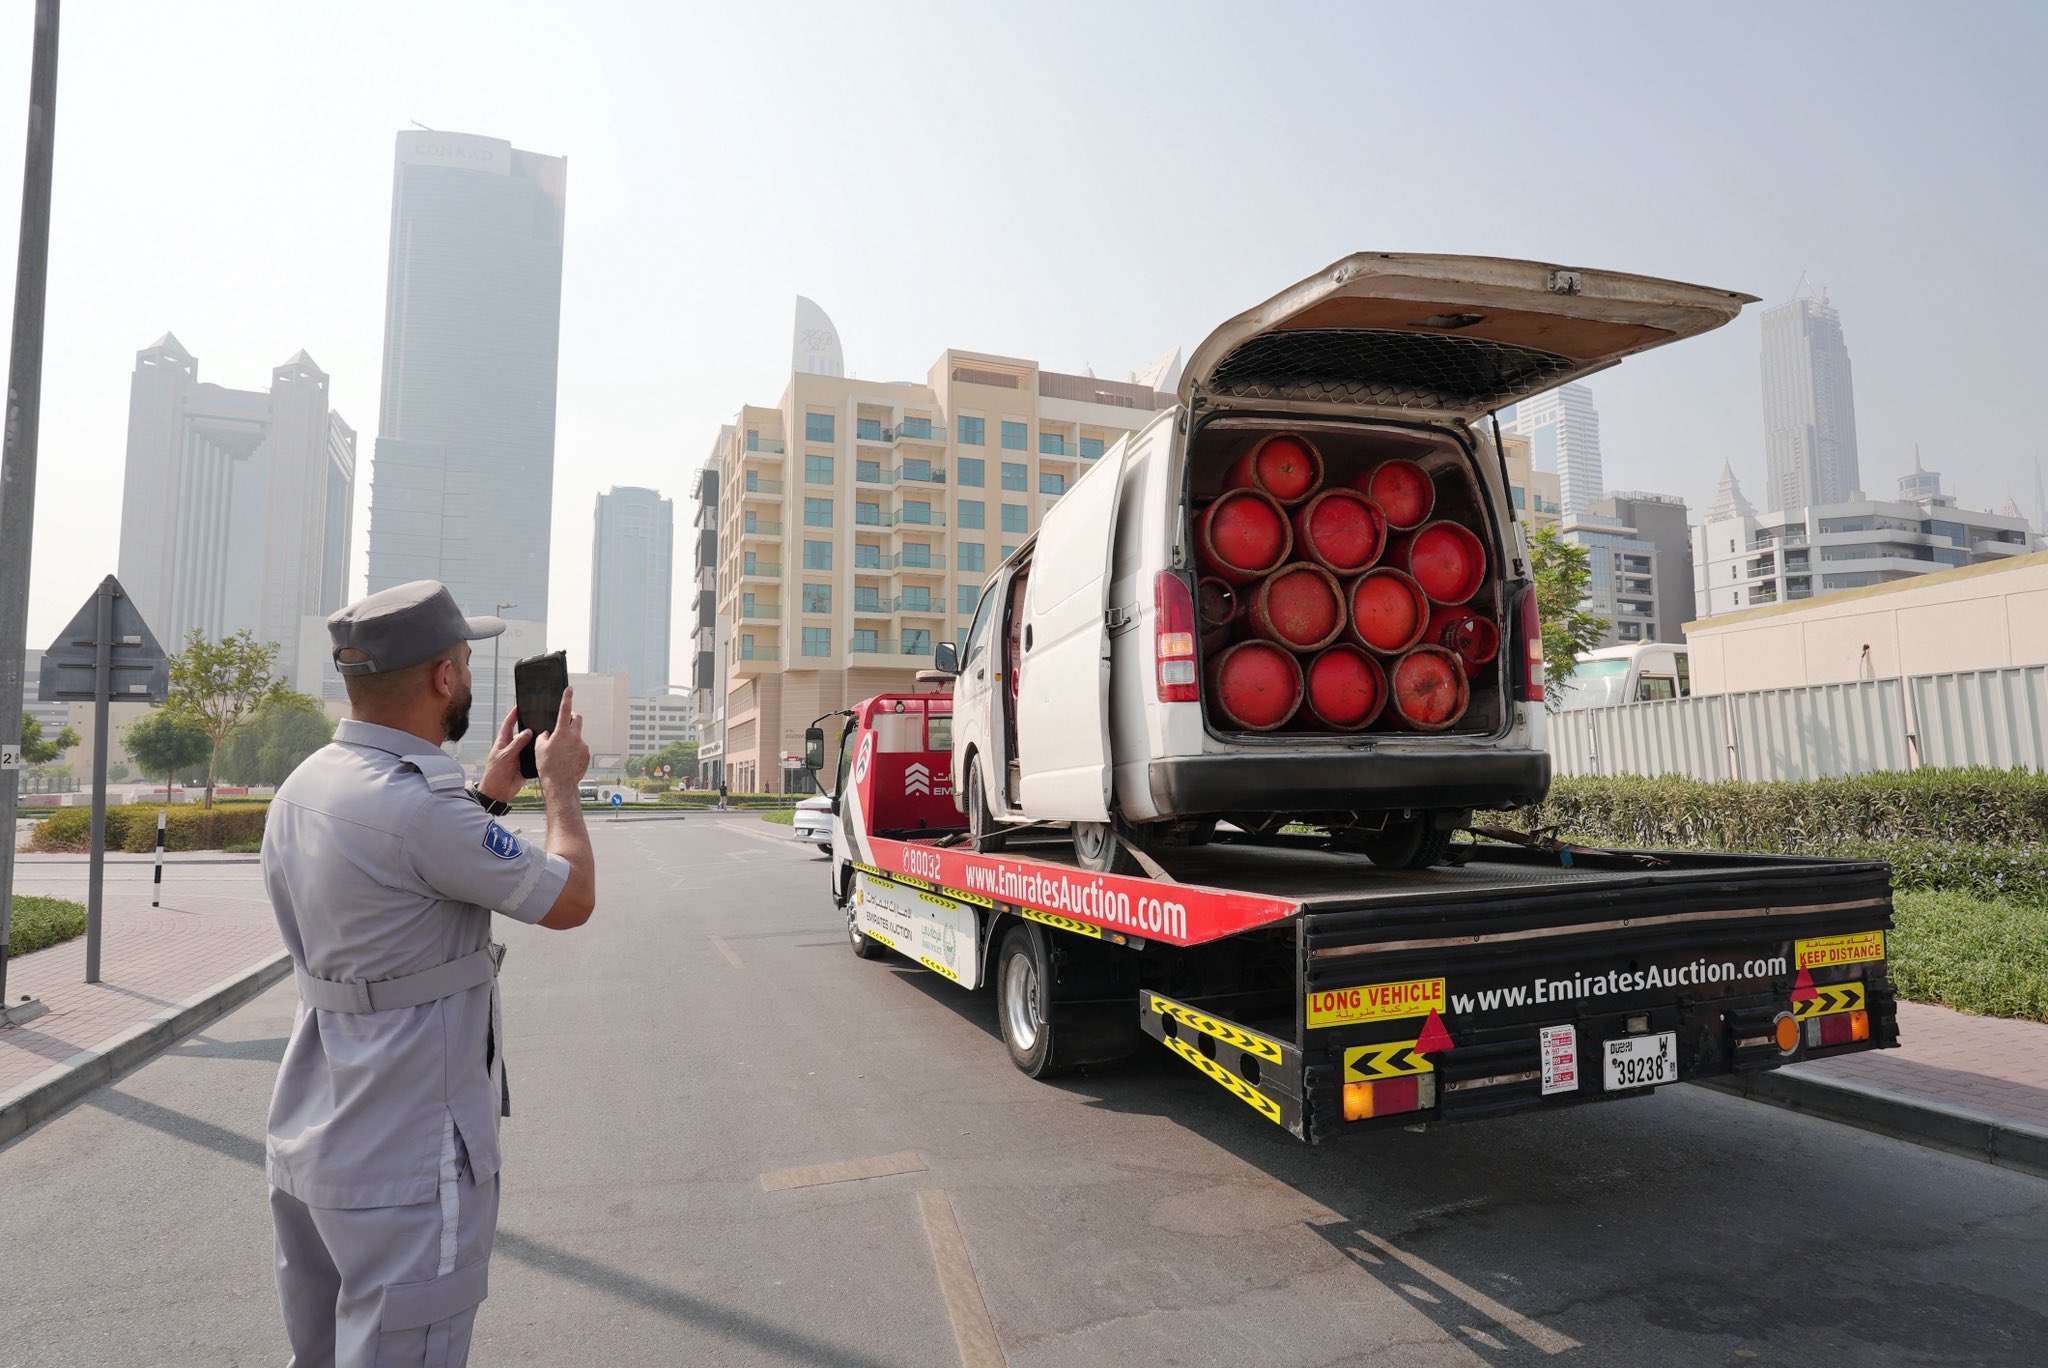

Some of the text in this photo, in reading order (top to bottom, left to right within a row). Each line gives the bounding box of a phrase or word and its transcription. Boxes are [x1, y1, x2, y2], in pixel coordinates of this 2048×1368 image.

[415, 144, 494, 161] CONRAD
[910, 849, 941, 880] 80032
[965, 864, 1187, 939] www.EmiratesAuction.com
[866, 911, 913, 941] EMIRATES AUCTION
[1799, 944, 1881, 965] KEEP DISTANCE
[1313, 982, 1441, 1013] LONG VEHICLE
[1451, 956, 1787, 1015] www.EmiratesAuction.com
[1659, 1036, 1668, 1052] W
[1617, 1054, 1664, 1086] 39238
